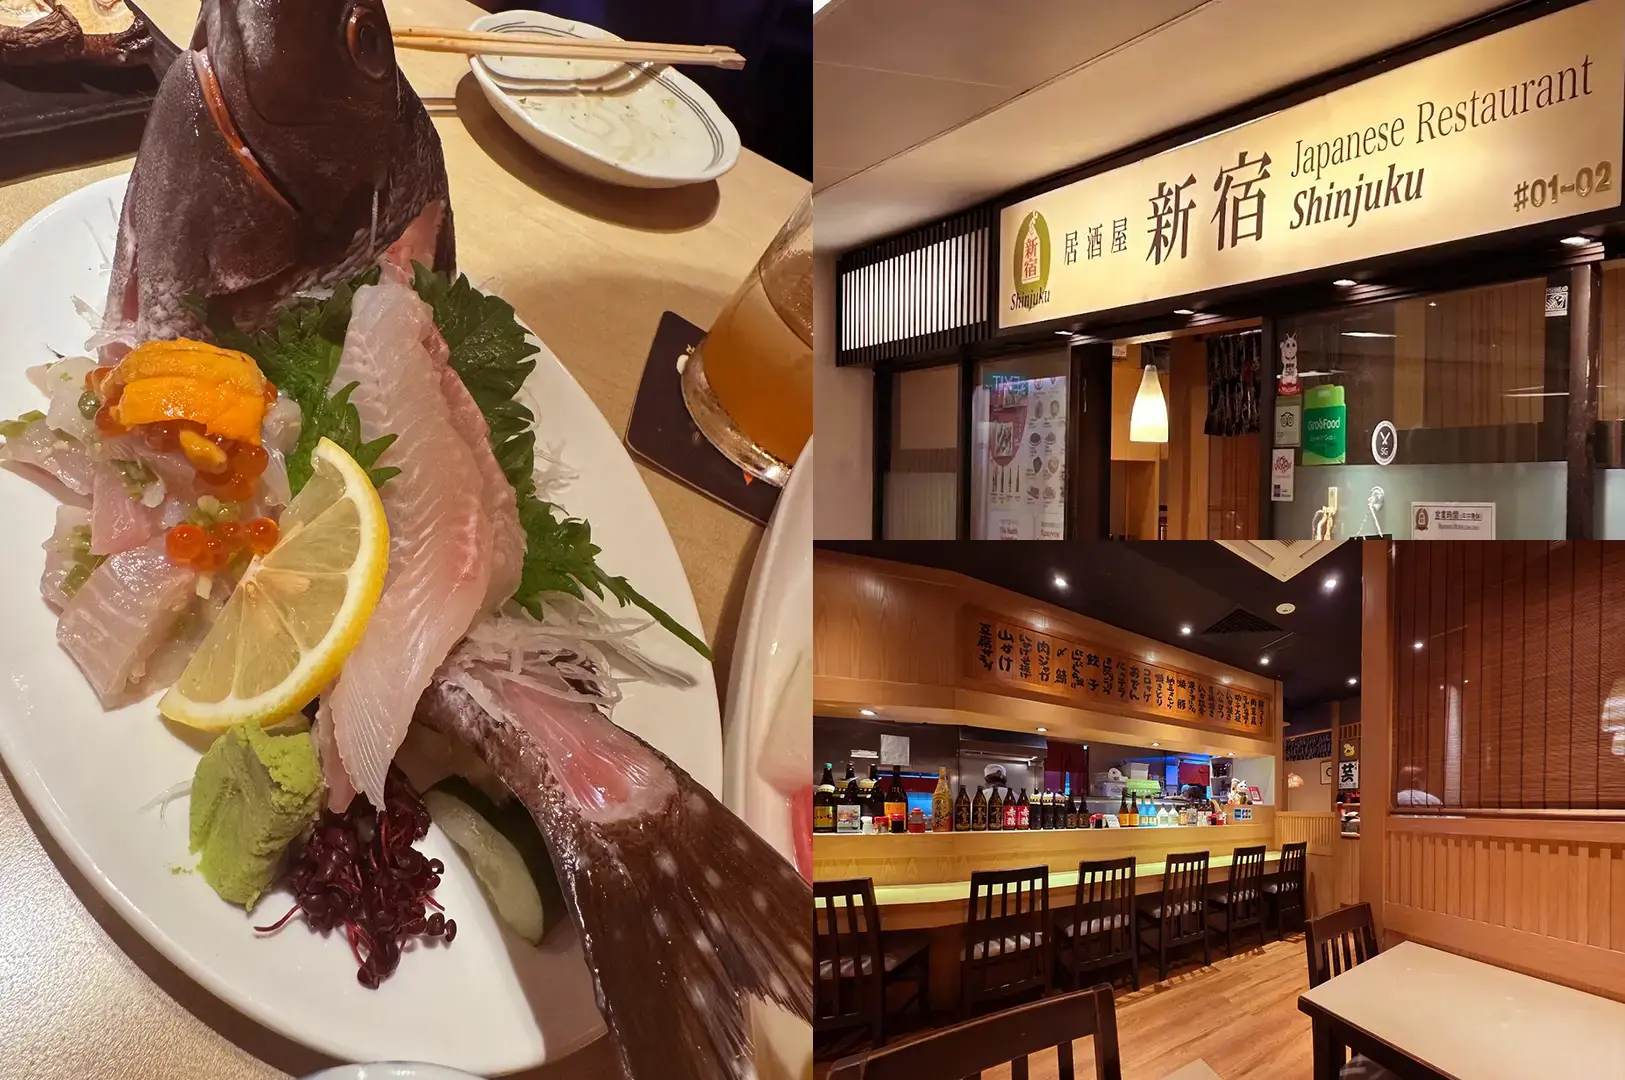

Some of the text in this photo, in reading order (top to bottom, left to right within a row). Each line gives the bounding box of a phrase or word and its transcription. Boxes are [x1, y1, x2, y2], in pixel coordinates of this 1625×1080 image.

[1290, 53, 1595, 179] Japanese Restaurant
[1145, 150, 1273, 267] 新宿
[1290, 165, 1425, 234] Shinjuku
[1513, 161, 1613, 211] #01-02
[1064, 217, 1130, 266] 居酒屋
[1010, 287, 1051, 312] Shinjuku
[998, 628, 1014, 672] 山かけ
[1129, 665, 1140, 700] おでん
[1143, 668, 1152, 703] コロッケ
